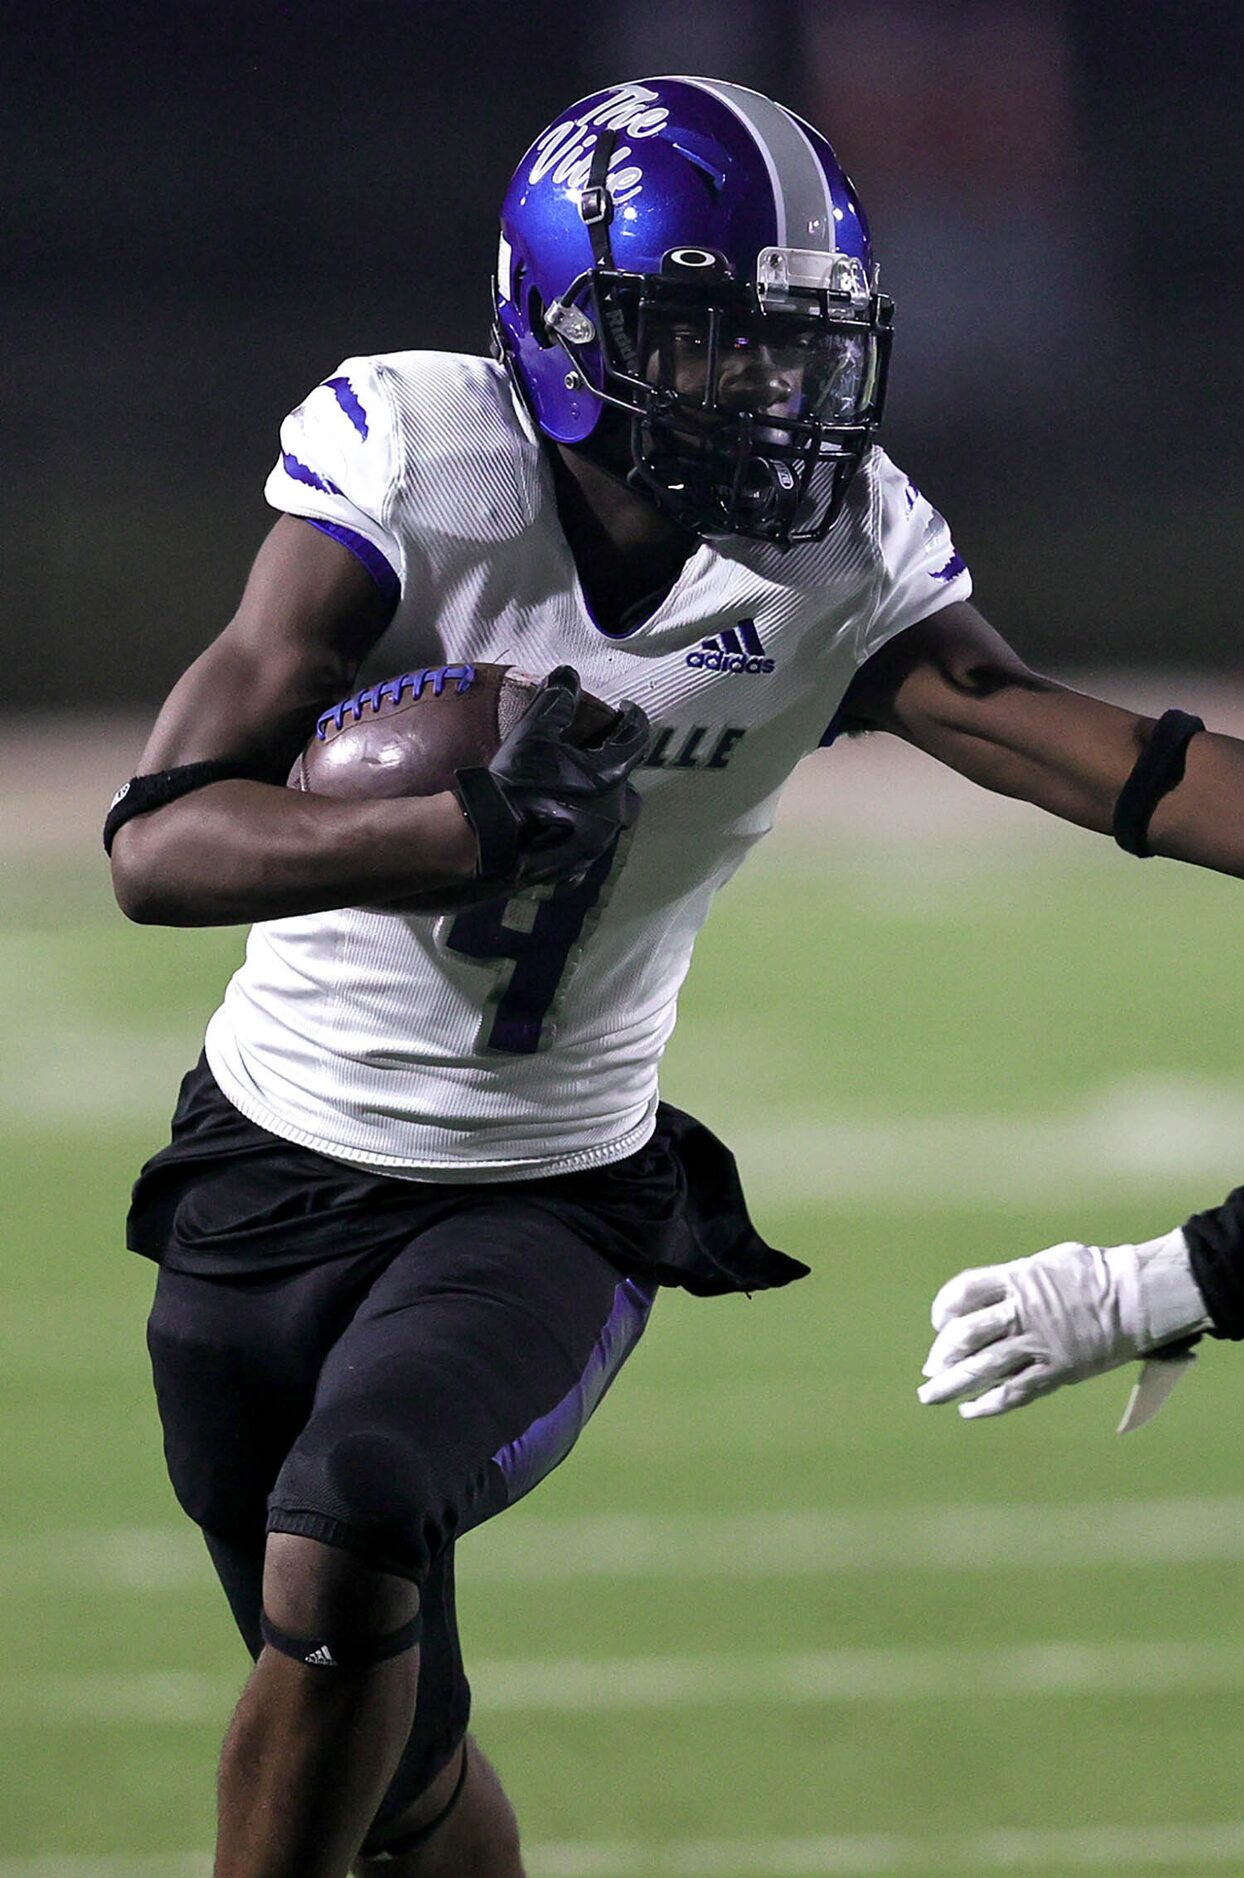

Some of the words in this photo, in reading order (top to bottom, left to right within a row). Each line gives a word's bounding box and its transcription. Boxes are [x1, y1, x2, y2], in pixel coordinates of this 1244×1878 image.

[575, 84, 669, 139] The
[685, 650, 776, 674] adidas
[643, 726, 747, 768] LLE
